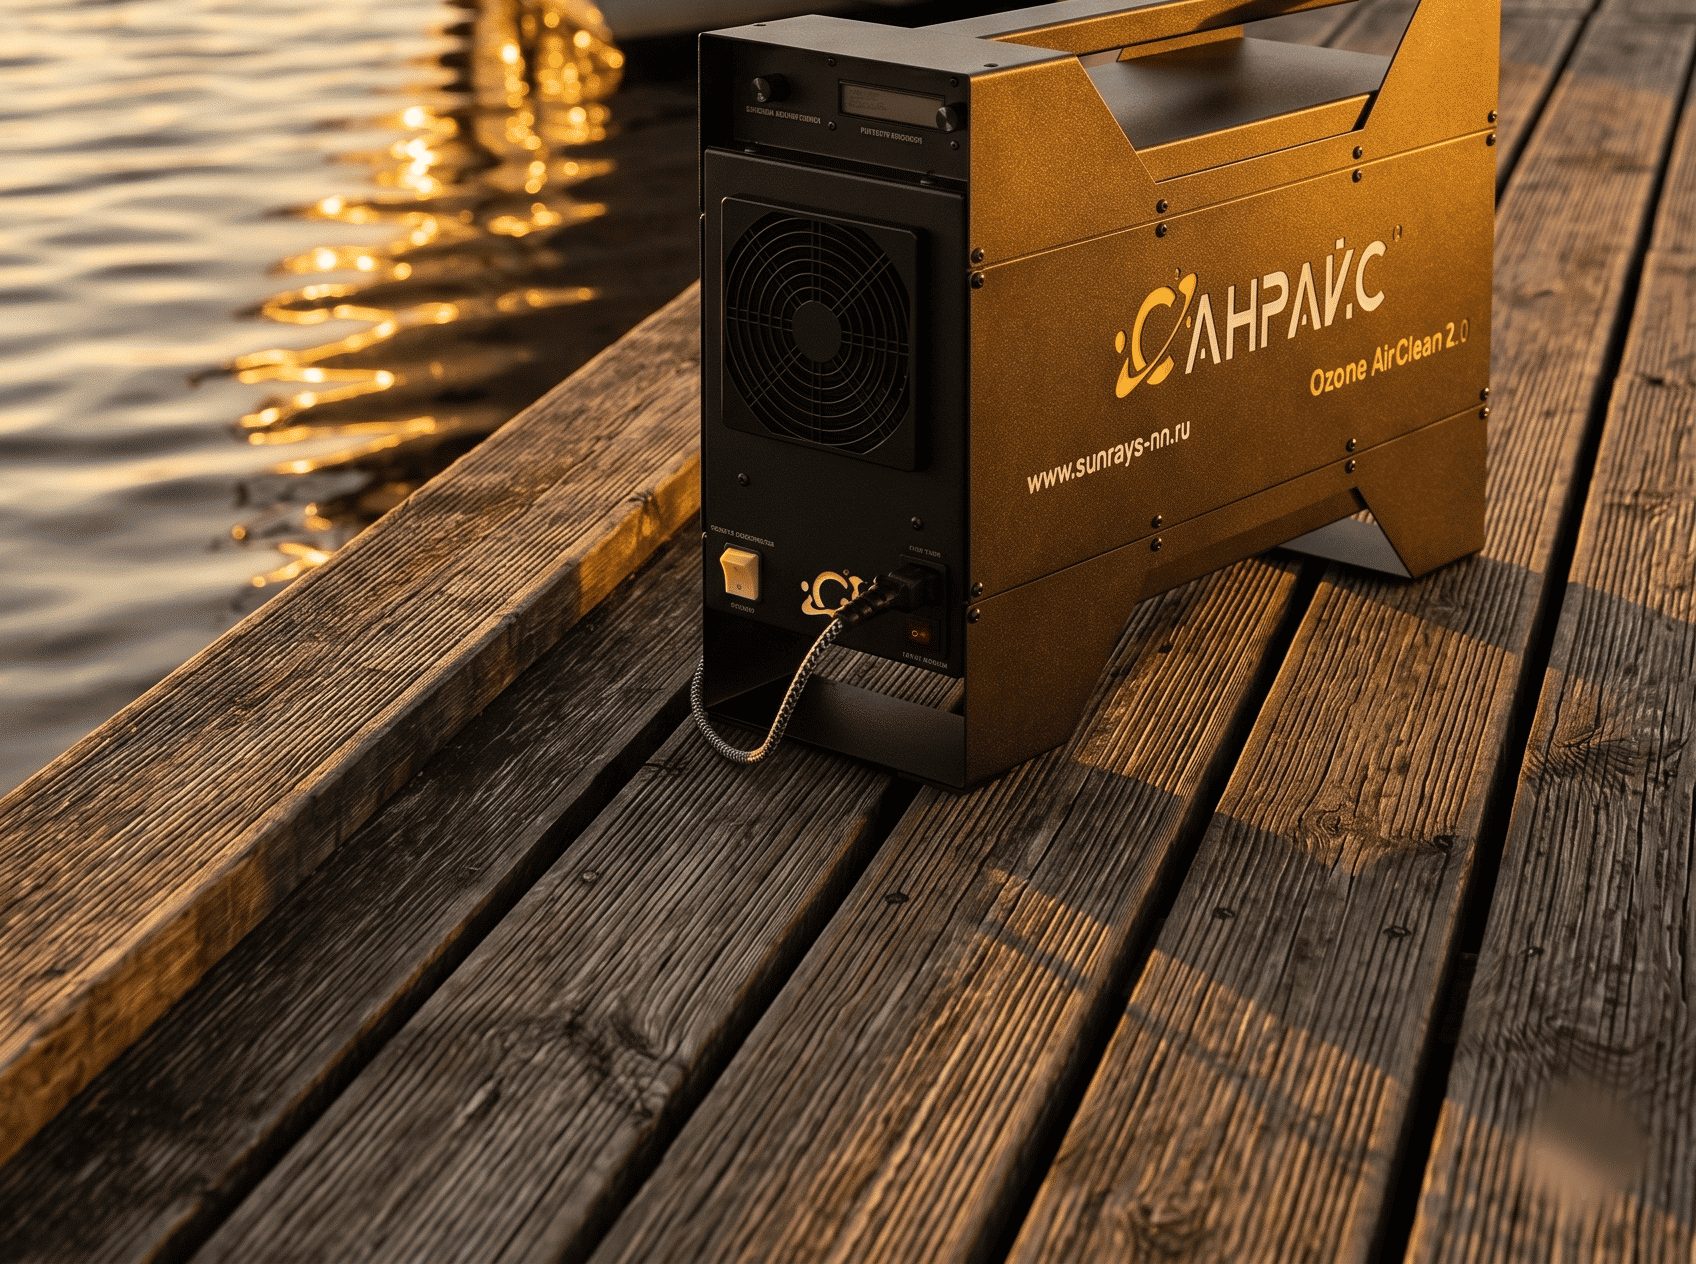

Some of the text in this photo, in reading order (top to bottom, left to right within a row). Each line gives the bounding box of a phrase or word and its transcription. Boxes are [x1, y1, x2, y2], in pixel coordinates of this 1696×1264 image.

[1310, 319, 1470, 396] Ozone AirClean 2.0
[1027, 421, 1191, 494] www.sunrays-nn.ru
